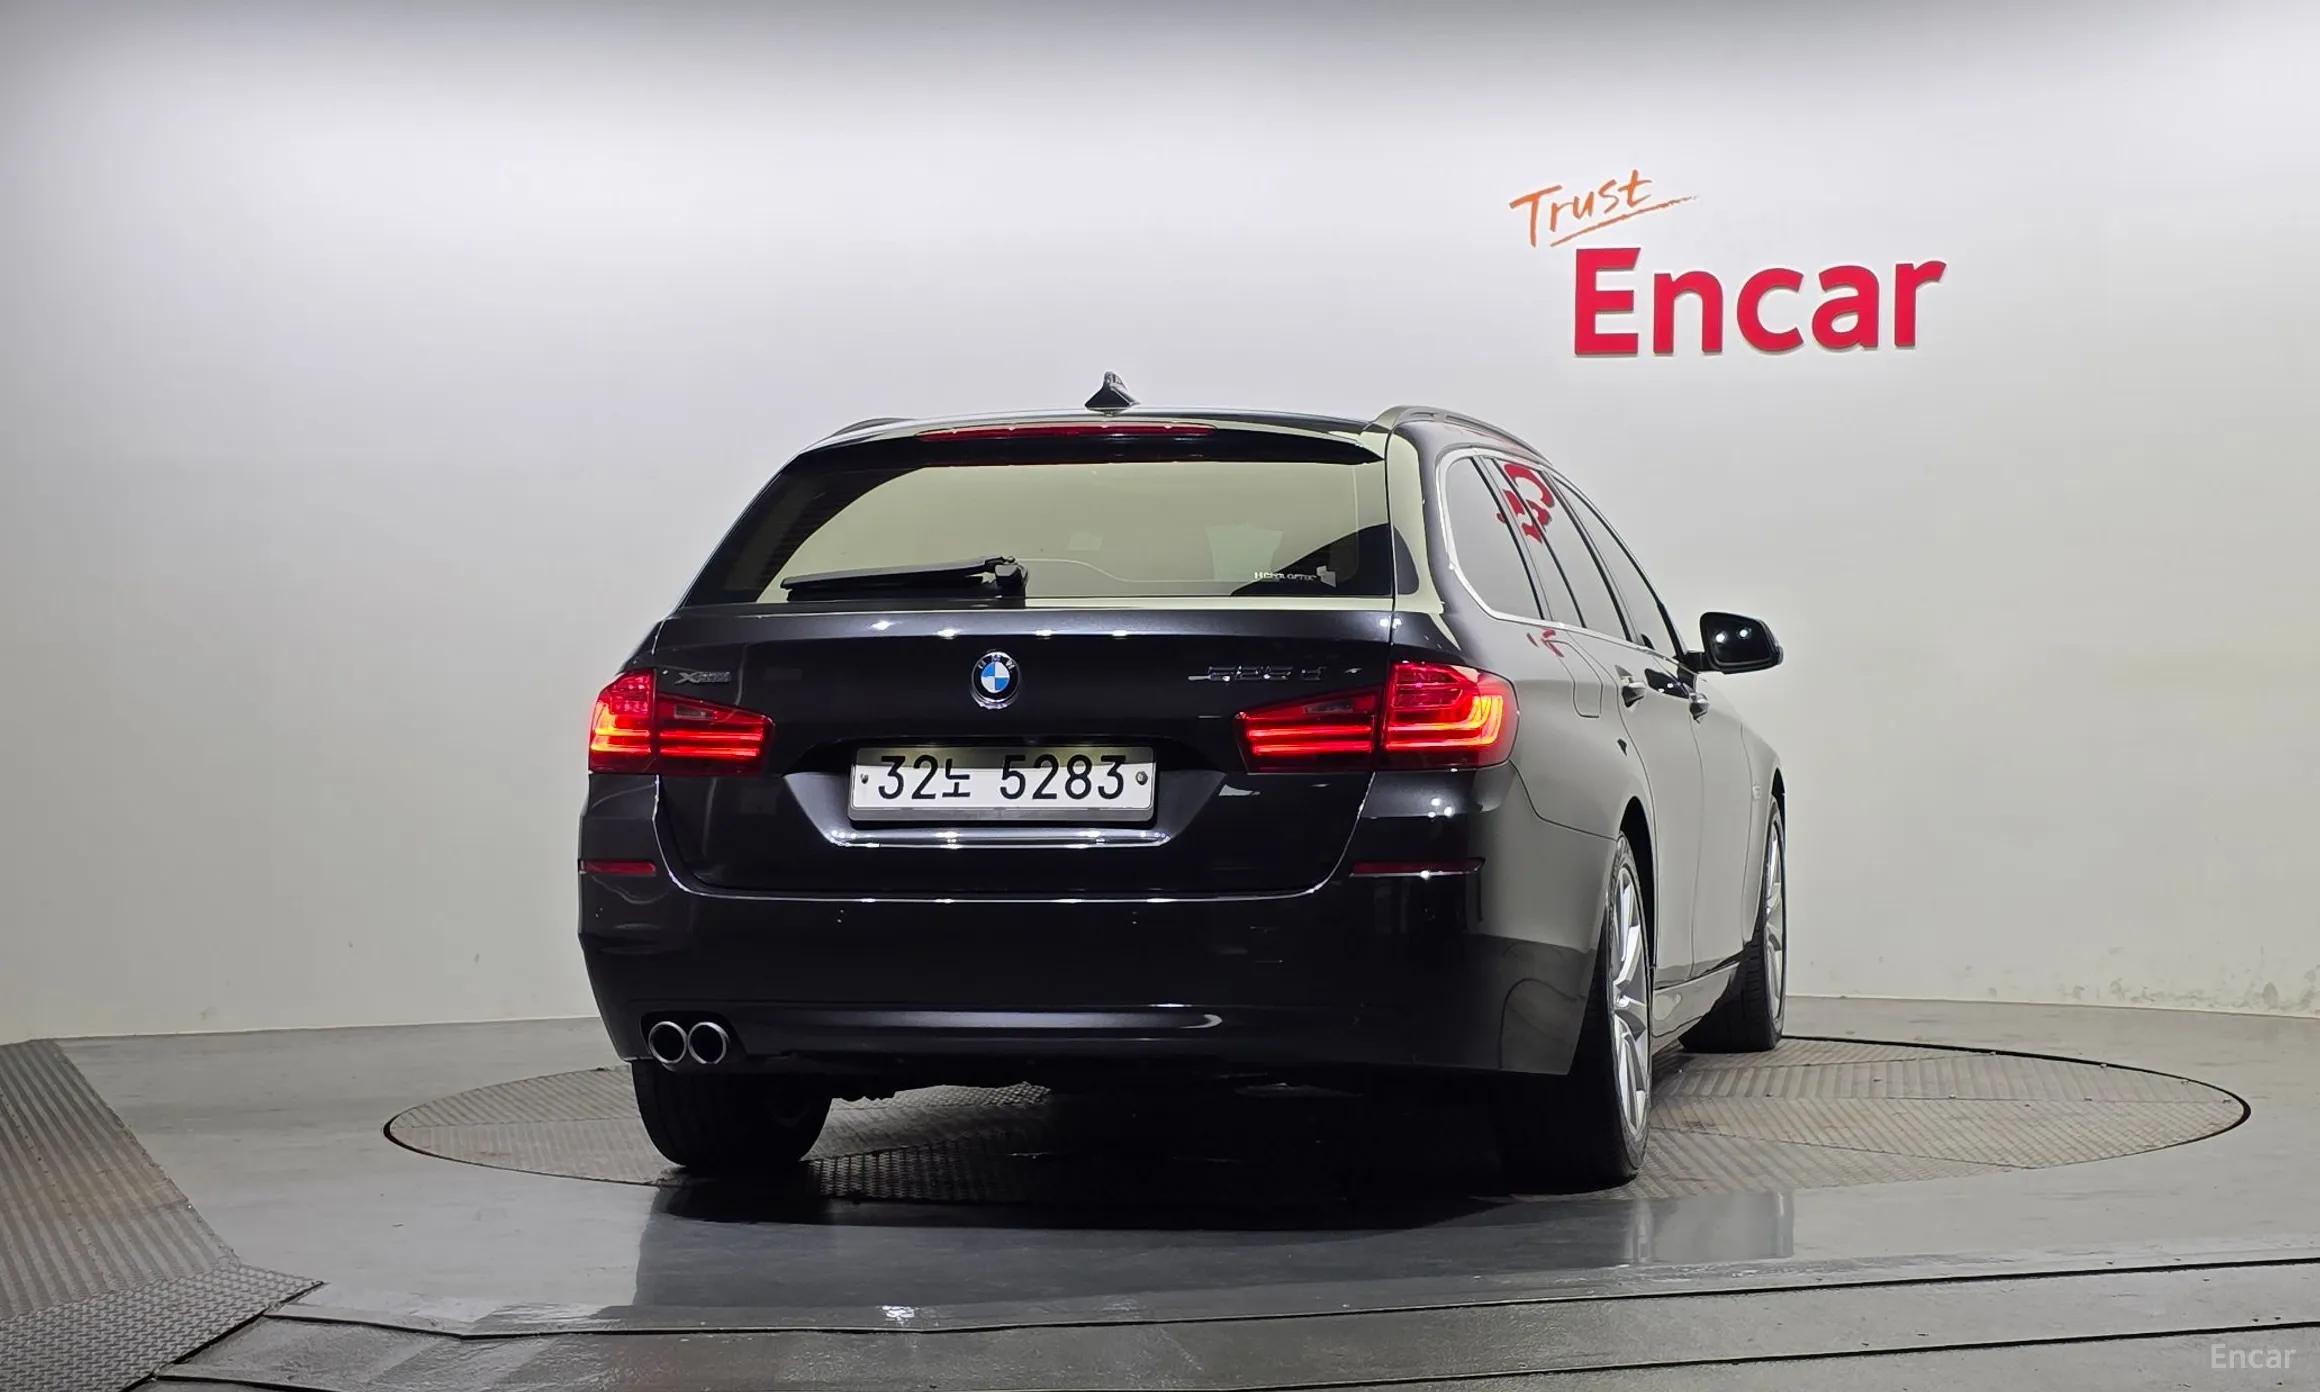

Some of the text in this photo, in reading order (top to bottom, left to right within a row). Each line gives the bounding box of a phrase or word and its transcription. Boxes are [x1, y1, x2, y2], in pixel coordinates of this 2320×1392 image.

[1509, 169, 1652, 247] Trust
[1575, 247, 1947, 355] Encar
[878, 754, 1127, 800] 32노 5283
